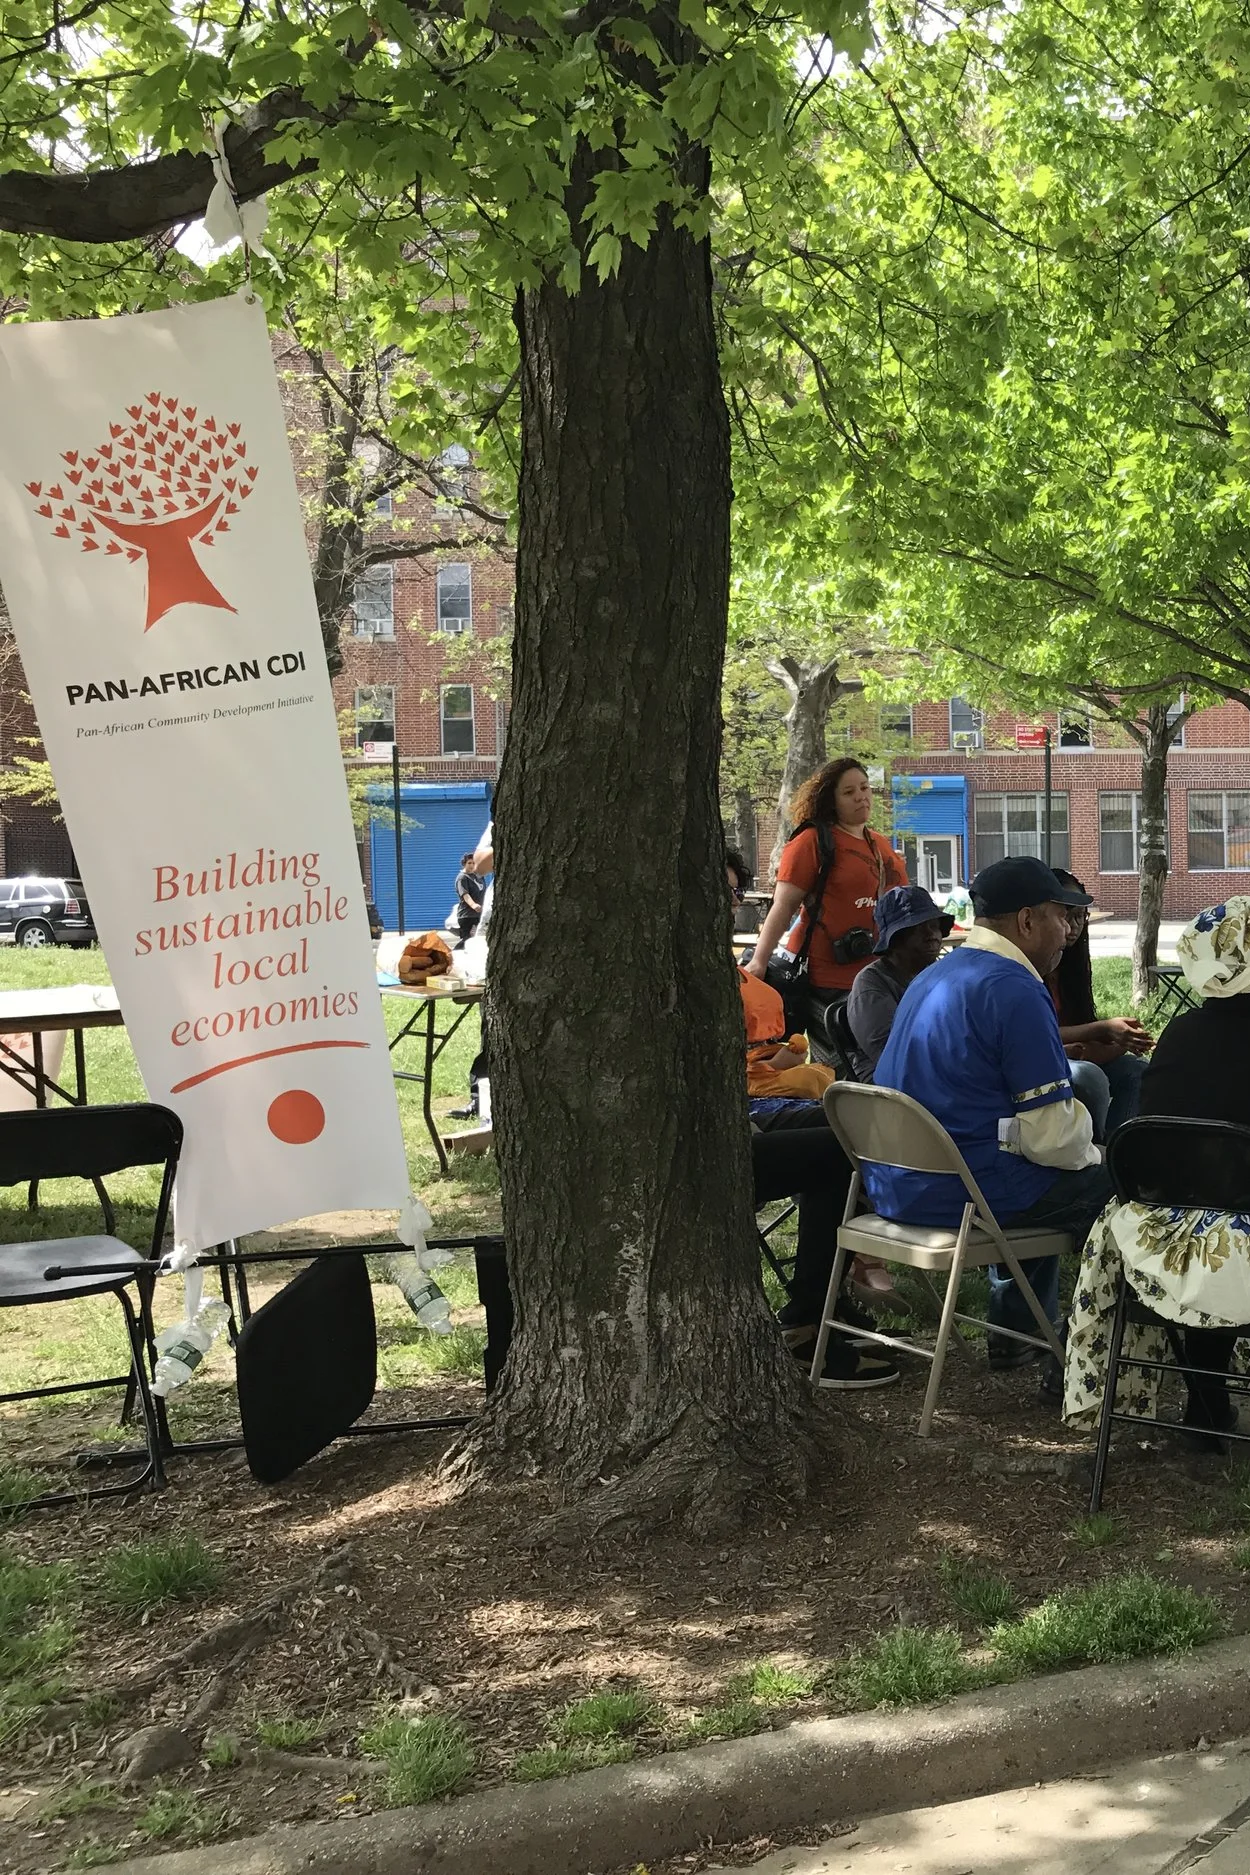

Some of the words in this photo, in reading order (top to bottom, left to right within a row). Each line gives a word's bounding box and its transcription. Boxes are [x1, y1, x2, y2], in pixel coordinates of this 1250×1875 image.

[66, 659, 261, 706] PAN-AFRICAN
[266, 651, 306, 677] CDI
[76, 721, 144, 738] Pan-African
[147, 711, 210, 729] Community
[213, 701, 275, 719] Development
[277, 693, 315, 708] Initiative
[152, 847, 321, 903] Building
[134, 886, 349, 957] sustainable
[212, 937, 310, 989] local
[171, 985, 359, 1046] economies
